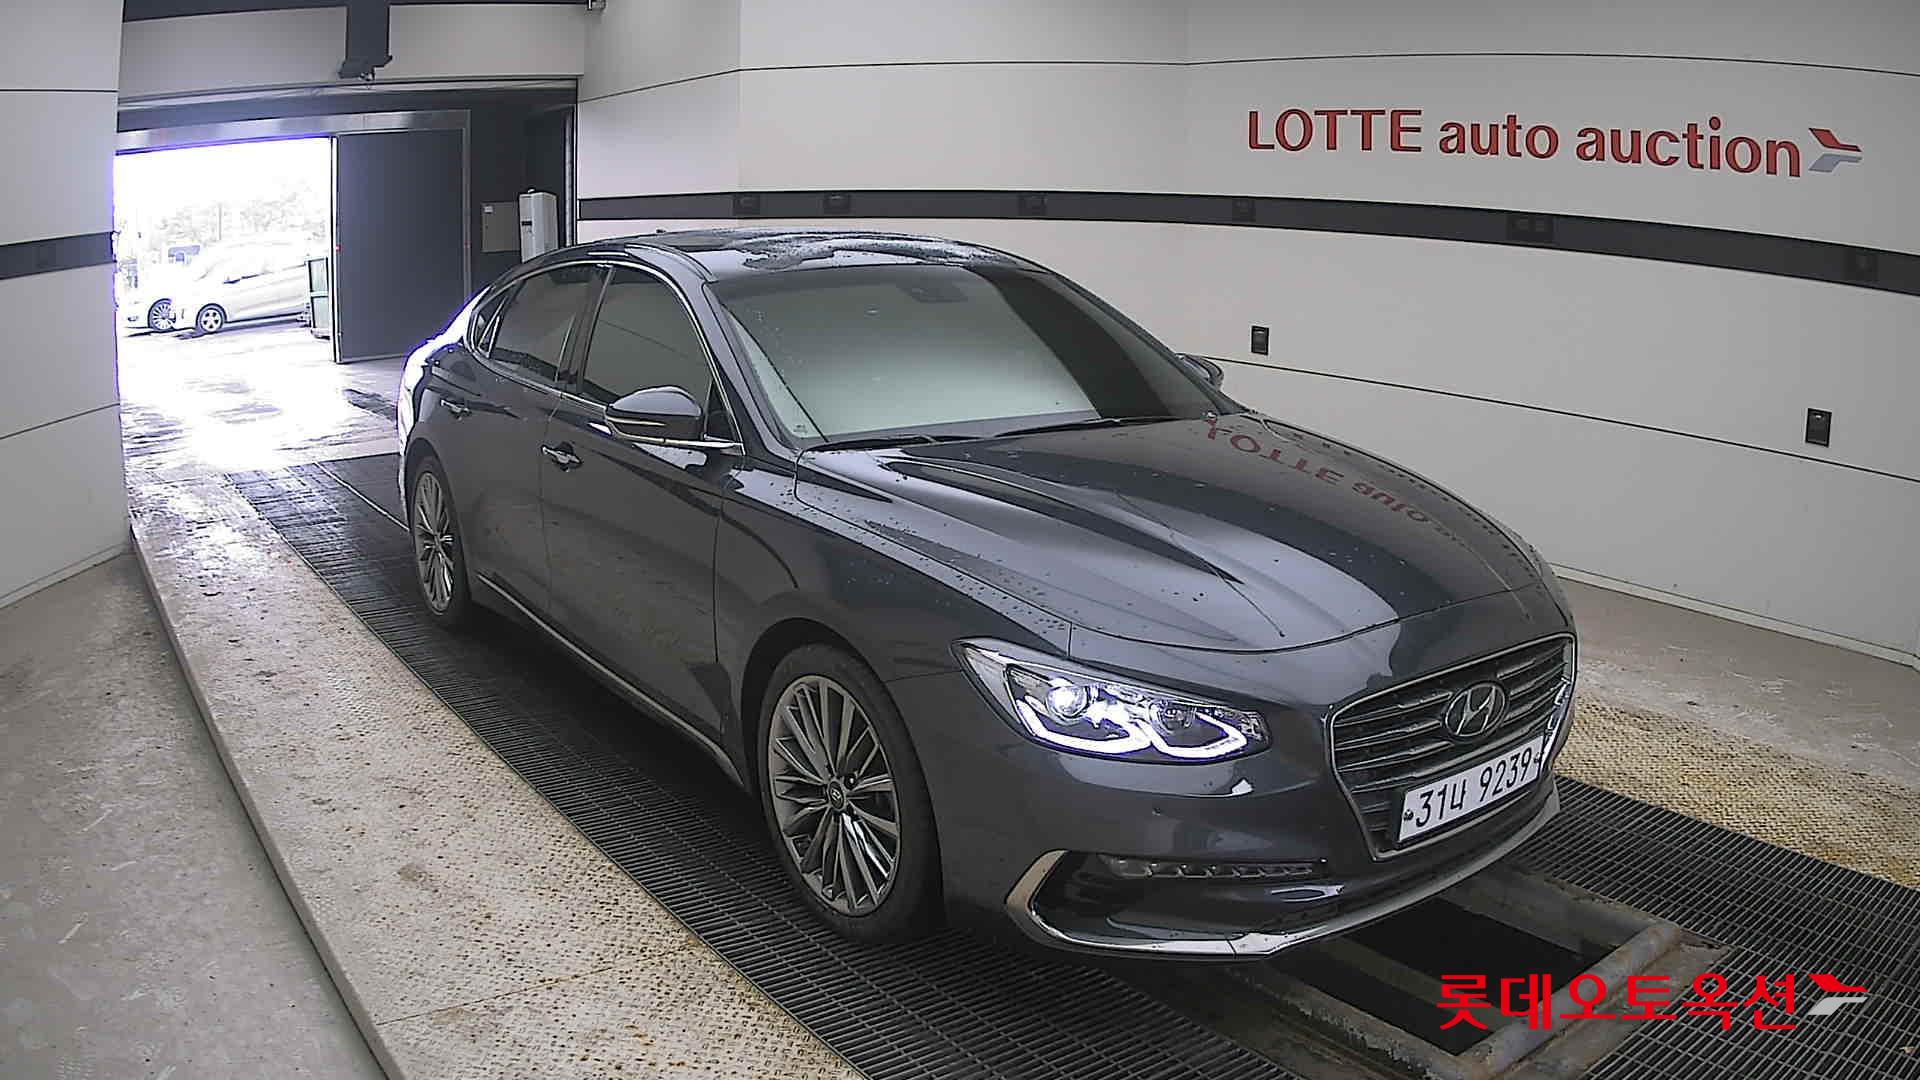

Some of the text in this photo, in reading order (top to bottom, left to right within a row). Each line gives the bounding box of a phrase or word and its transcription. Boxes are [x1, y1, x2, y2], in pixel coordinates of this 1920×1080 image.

[1247, 109, 1802, 178] LOTTE auto auction
[1480, 747, 1532, 802] 9239
